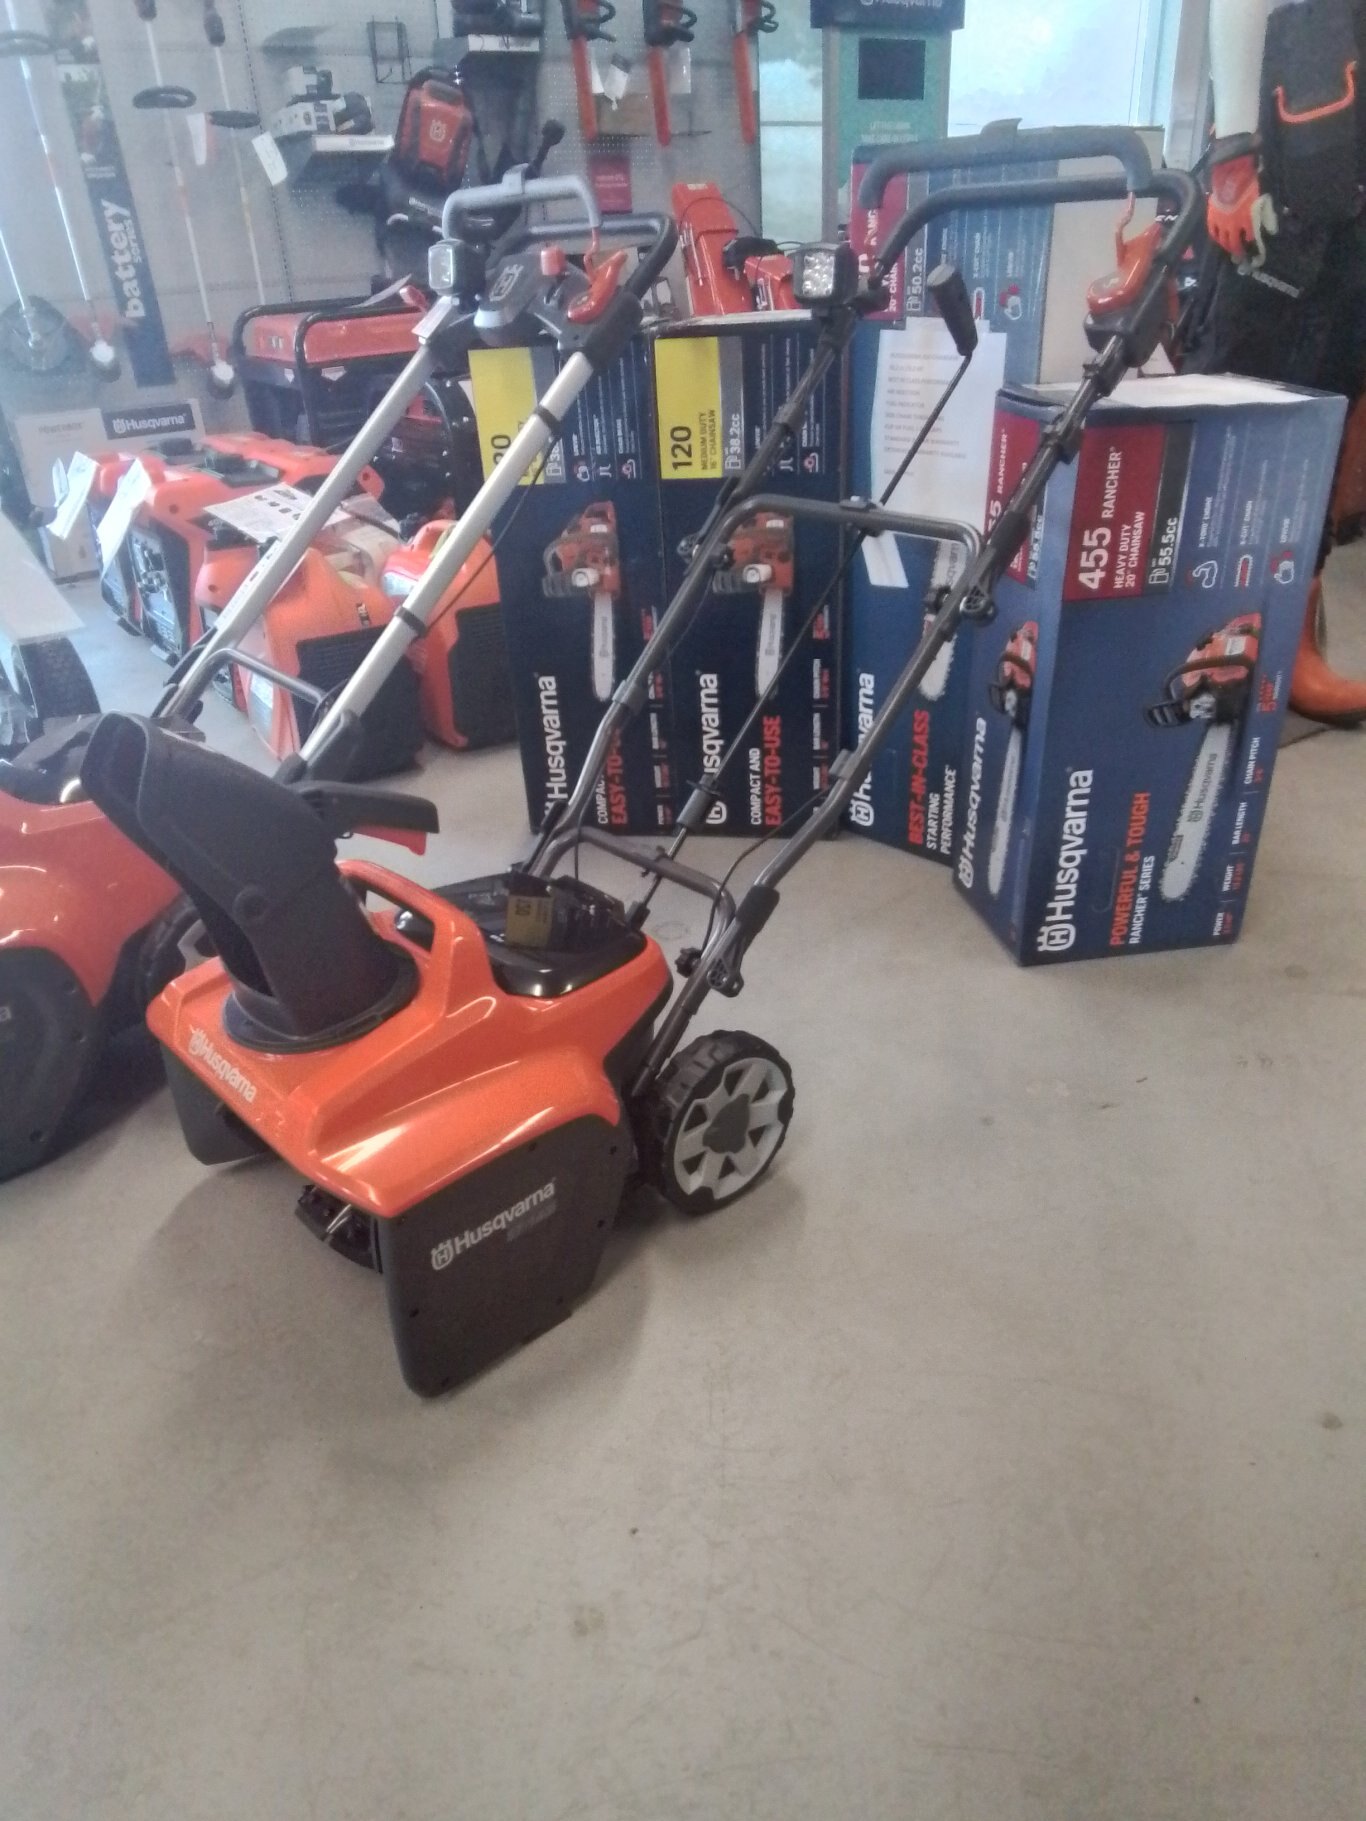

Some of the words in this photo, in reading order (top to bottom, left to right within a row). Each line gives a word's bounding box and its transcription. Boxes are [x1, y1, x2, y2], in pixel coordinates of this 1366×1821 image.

[101, 199, 145, 318] battery
[126, 414, 185, 431] Husqvarna
[670, 425, 692, 470] 120
[730, 413, 741, 454] 38.2cc
[1078, 527, 1112, 590] 455
[1102, 450, 1122, 519] RANCHER
[1119, 524, 1132, 551] DUTY
[1130, 511, 1146, 568] CHAINSAW
[1158, 517, 1178, 566] 55.5cc
[1113, 552, 1127, 589] HEAVY
[538, 675, 568, 799] Husqvarna
[700, 673, 725, 773] sqvarna
[1249, 737, 1260, 760] PITCH
[749, 748, 760, 771] AND
[763, 715, 782, 826] EASY-TO-USE
[908, 709, 929, 845] BEST-IN-CLASS
[961, 717, 986, 860] Husqvarna
[750, 773, 762, 825] COMPACT
[926, 792, 940, 850] STARTING
[940, 767, 956, 854] PERFORMANCE
[1045, 769, 1093, 922] Husqvarna
[1110, 866, 1139, 946] POWERFUL
[1127, 792, 1151, 846] TOUGH
[1128, 896, 1147, 945] RANCHER
[1139, 855, 1155, 891] SERIES
[203, 1039, 257, 1103] Husqvarna
[454, 1182, 556, 1255] Husqvarna
